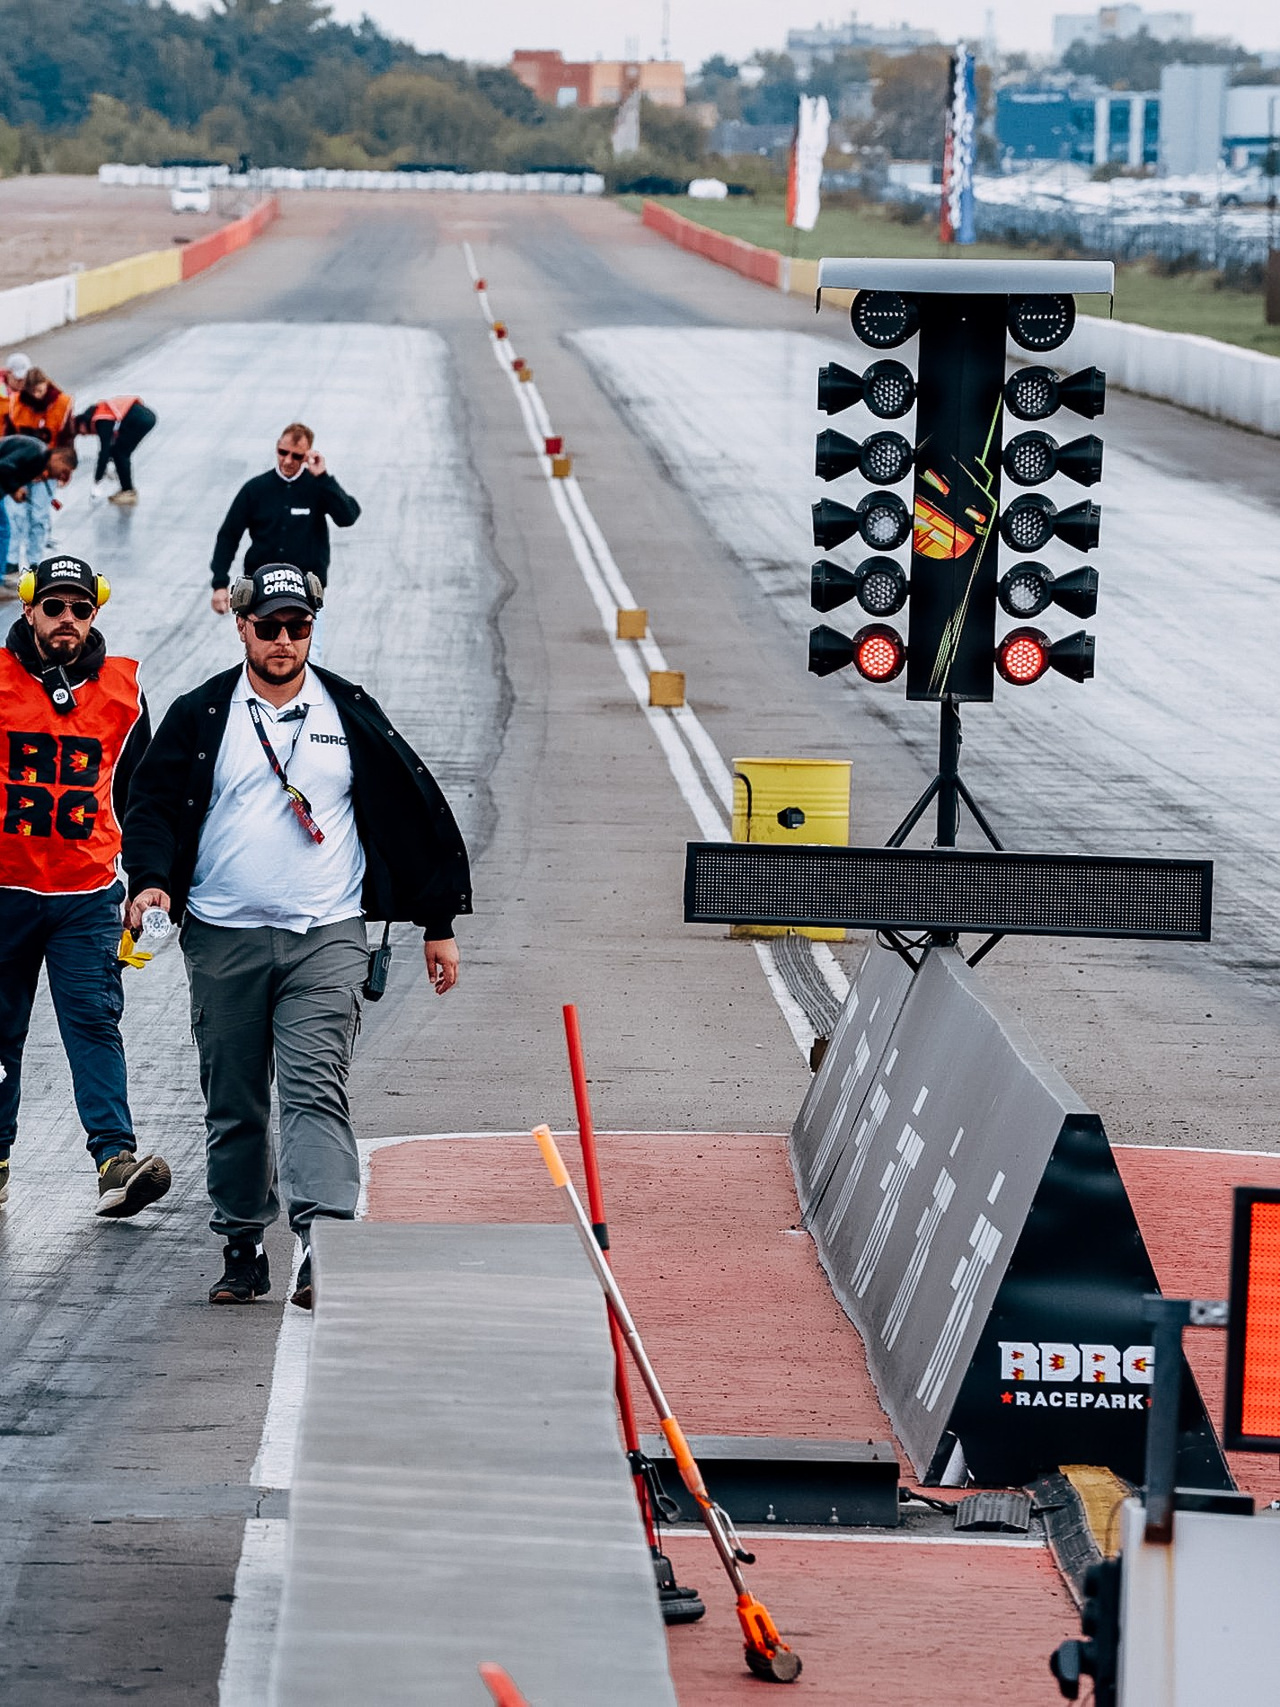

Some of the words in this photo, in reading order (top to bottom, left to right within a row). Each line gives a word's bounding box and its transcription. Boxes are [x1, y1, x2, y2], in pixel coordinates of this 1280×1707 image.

[51, 560, 81, 572] RDRC
[51, 569, 81, 579] Official
[262, 569, 304, 586] RDRC
[263, 580, 307, 598] Official
[310, 733, 348, 746] RDRC
[7, 731, 103, 787] RD
[3, 783, 99, 840] RC
[998, 1341, 1156, 1385] RDRC
[1015, 1391, 1145, 1410] RACEPARK
